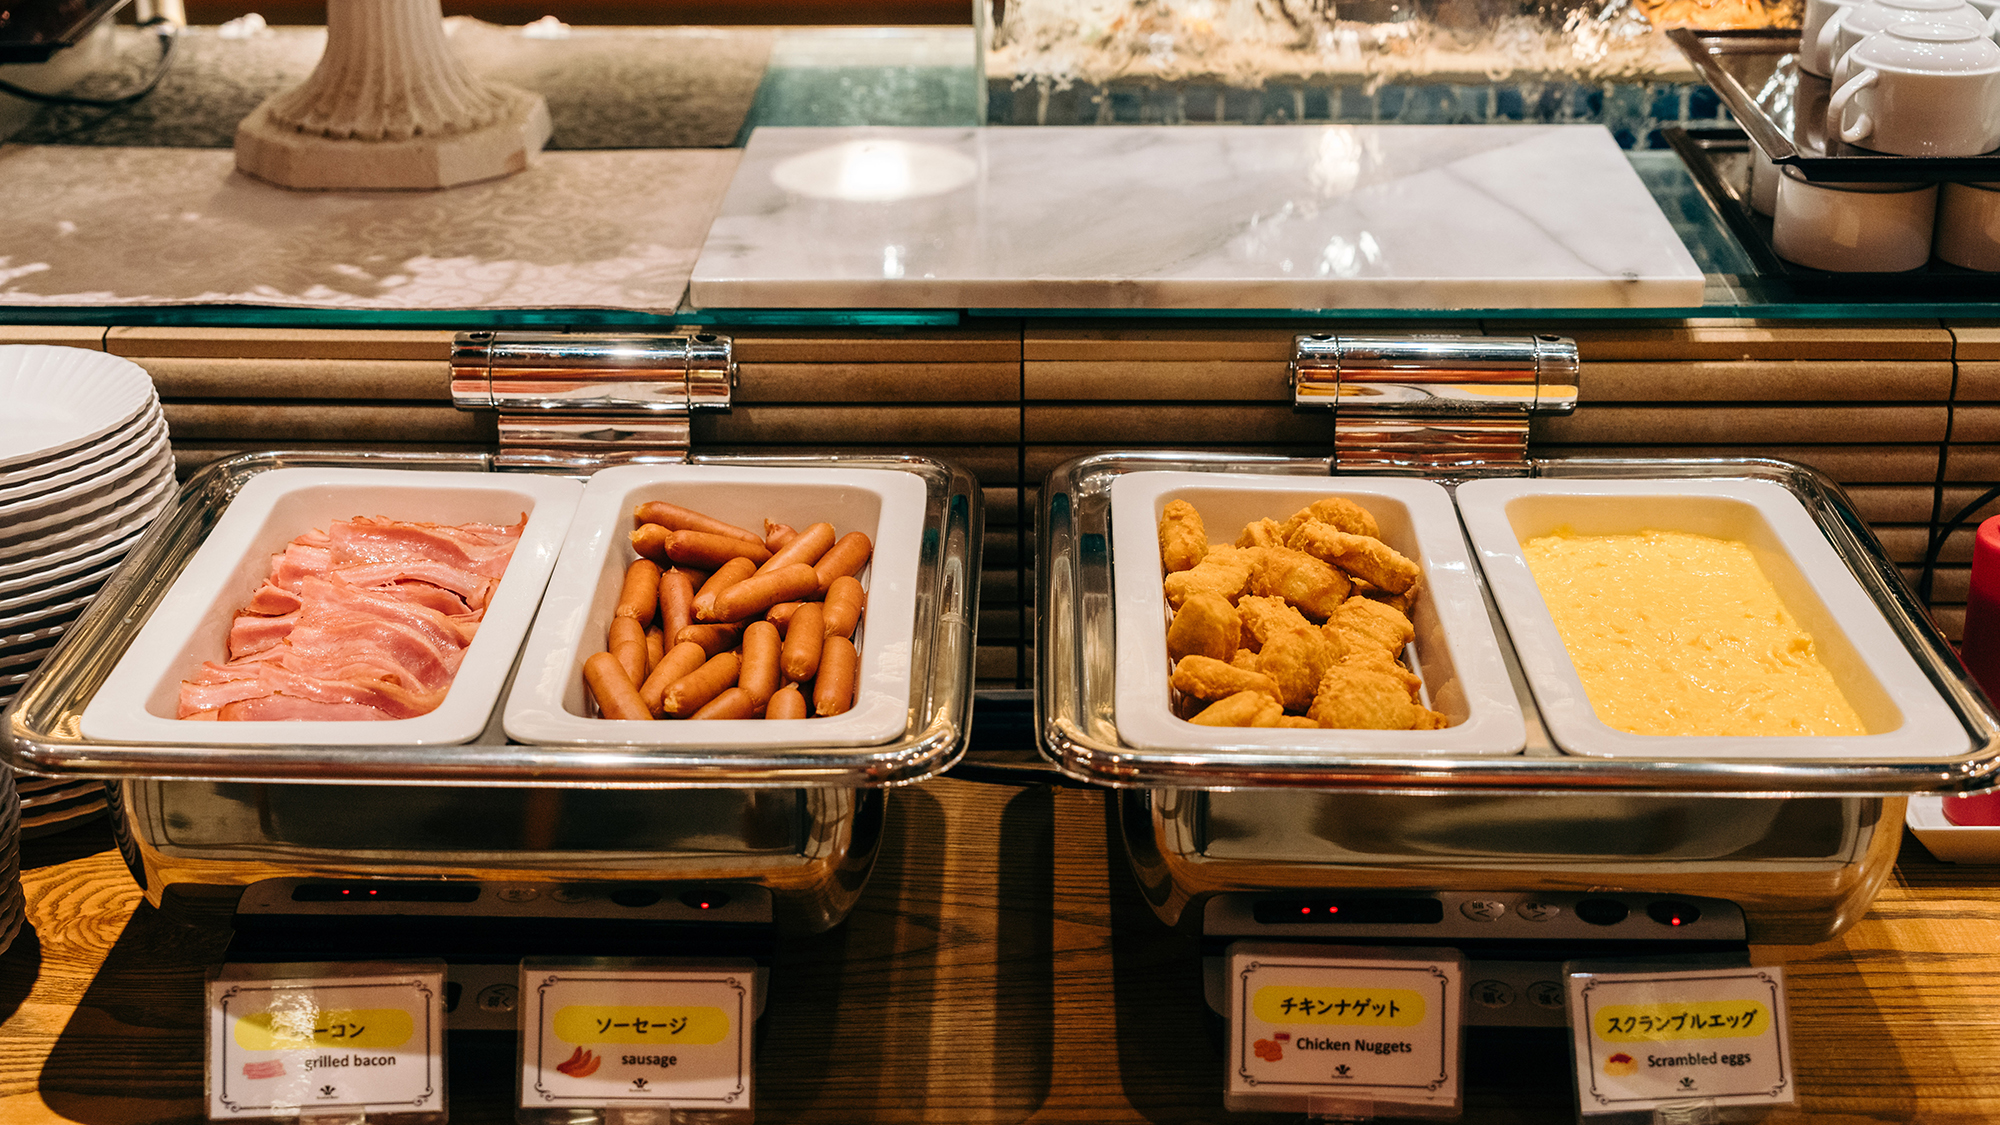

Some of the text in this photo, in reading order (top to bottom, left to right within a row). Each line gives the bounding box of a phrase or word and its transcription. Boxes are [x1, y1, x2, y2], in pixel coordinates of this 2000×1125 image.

[1280, 997, 1400, 1018] チキンナゲット
[597, 1016, 688, 1035] ソーセージ
[1607, 1008, 1758, 1034] スクランブルエッグ
[1296, 1037, 1412, 1055] Chicken Nuggets
[305, 1054, 396, 1072] grilled bacon
[621, 1054, 677, 1068] sausage
[1648, 1051, 1751, 1068] Scrambled eggs
